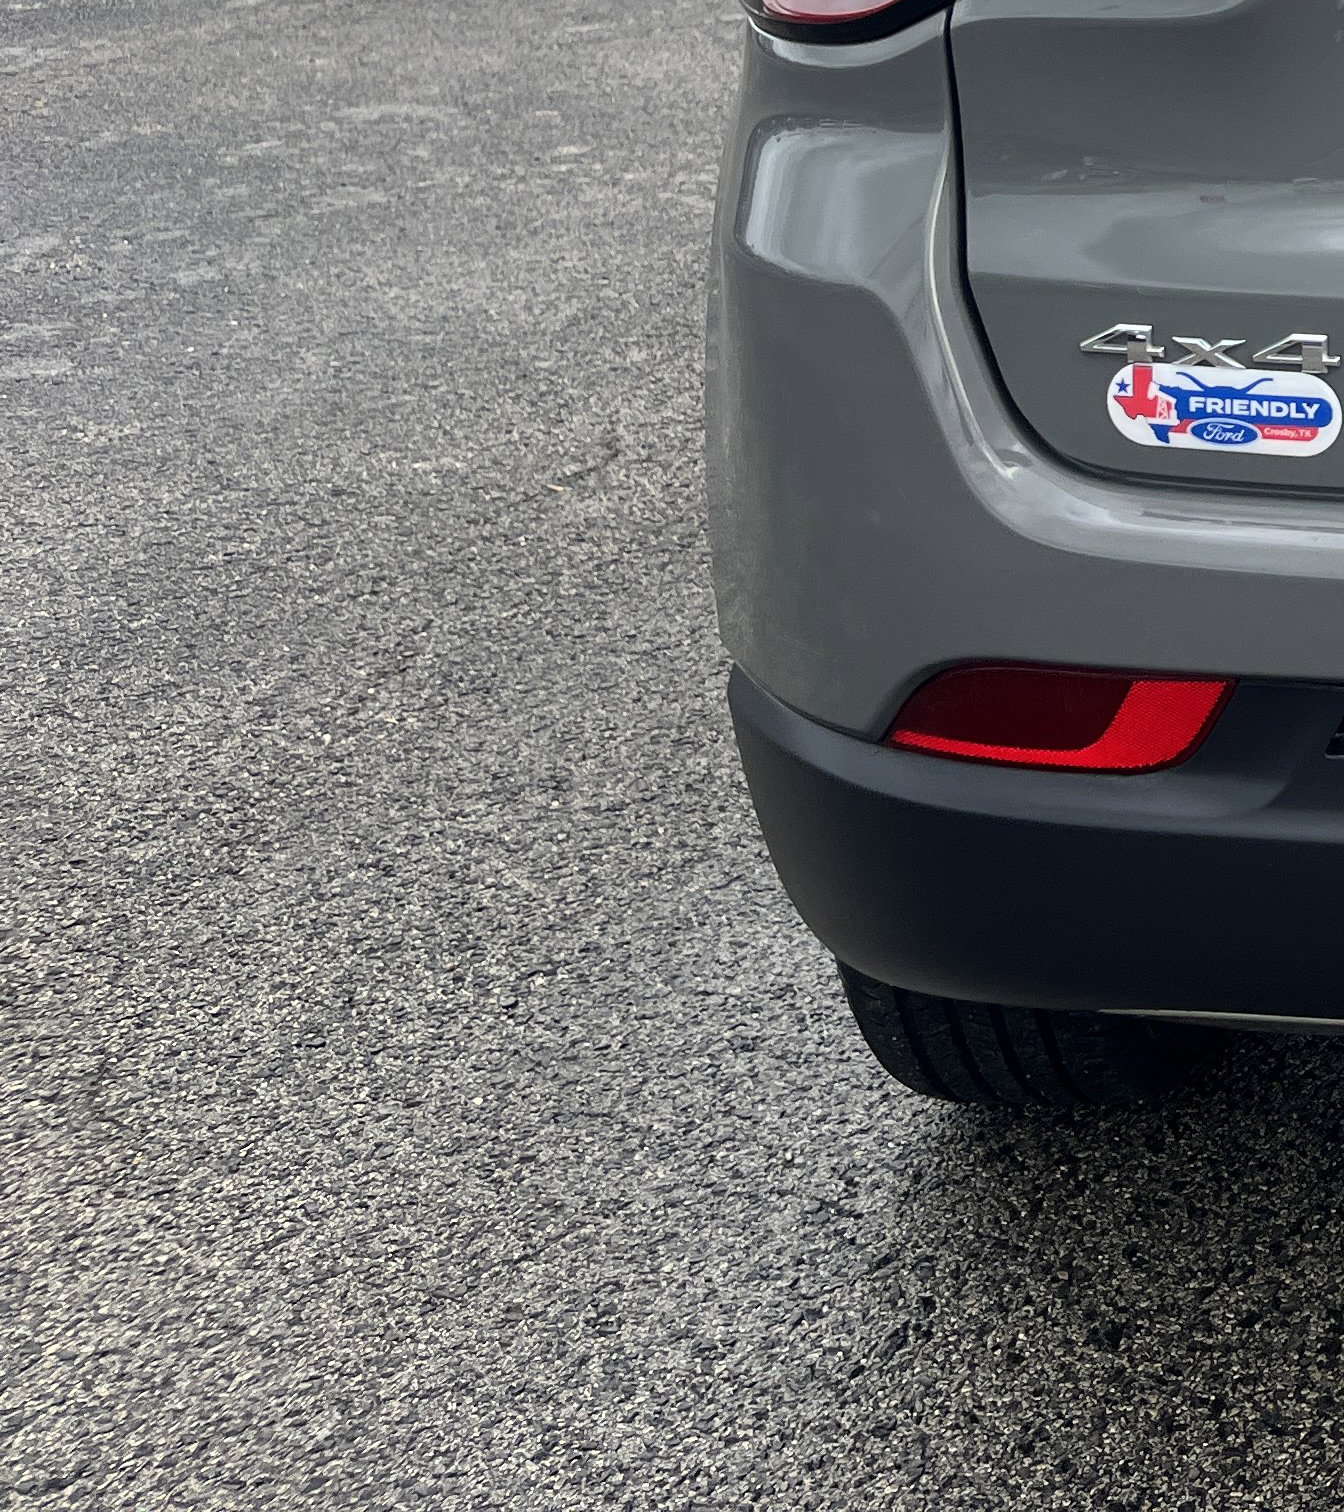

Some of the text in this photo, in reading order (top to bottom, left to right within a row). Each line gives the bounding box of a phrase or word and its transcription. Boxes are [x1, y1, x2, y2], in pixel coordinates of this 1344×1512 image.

[1188, 396, 1321, 419] FRIENDLY
[1202, 422, 1246, 442] Ford
[1299, 428, 1312, 438] TX
